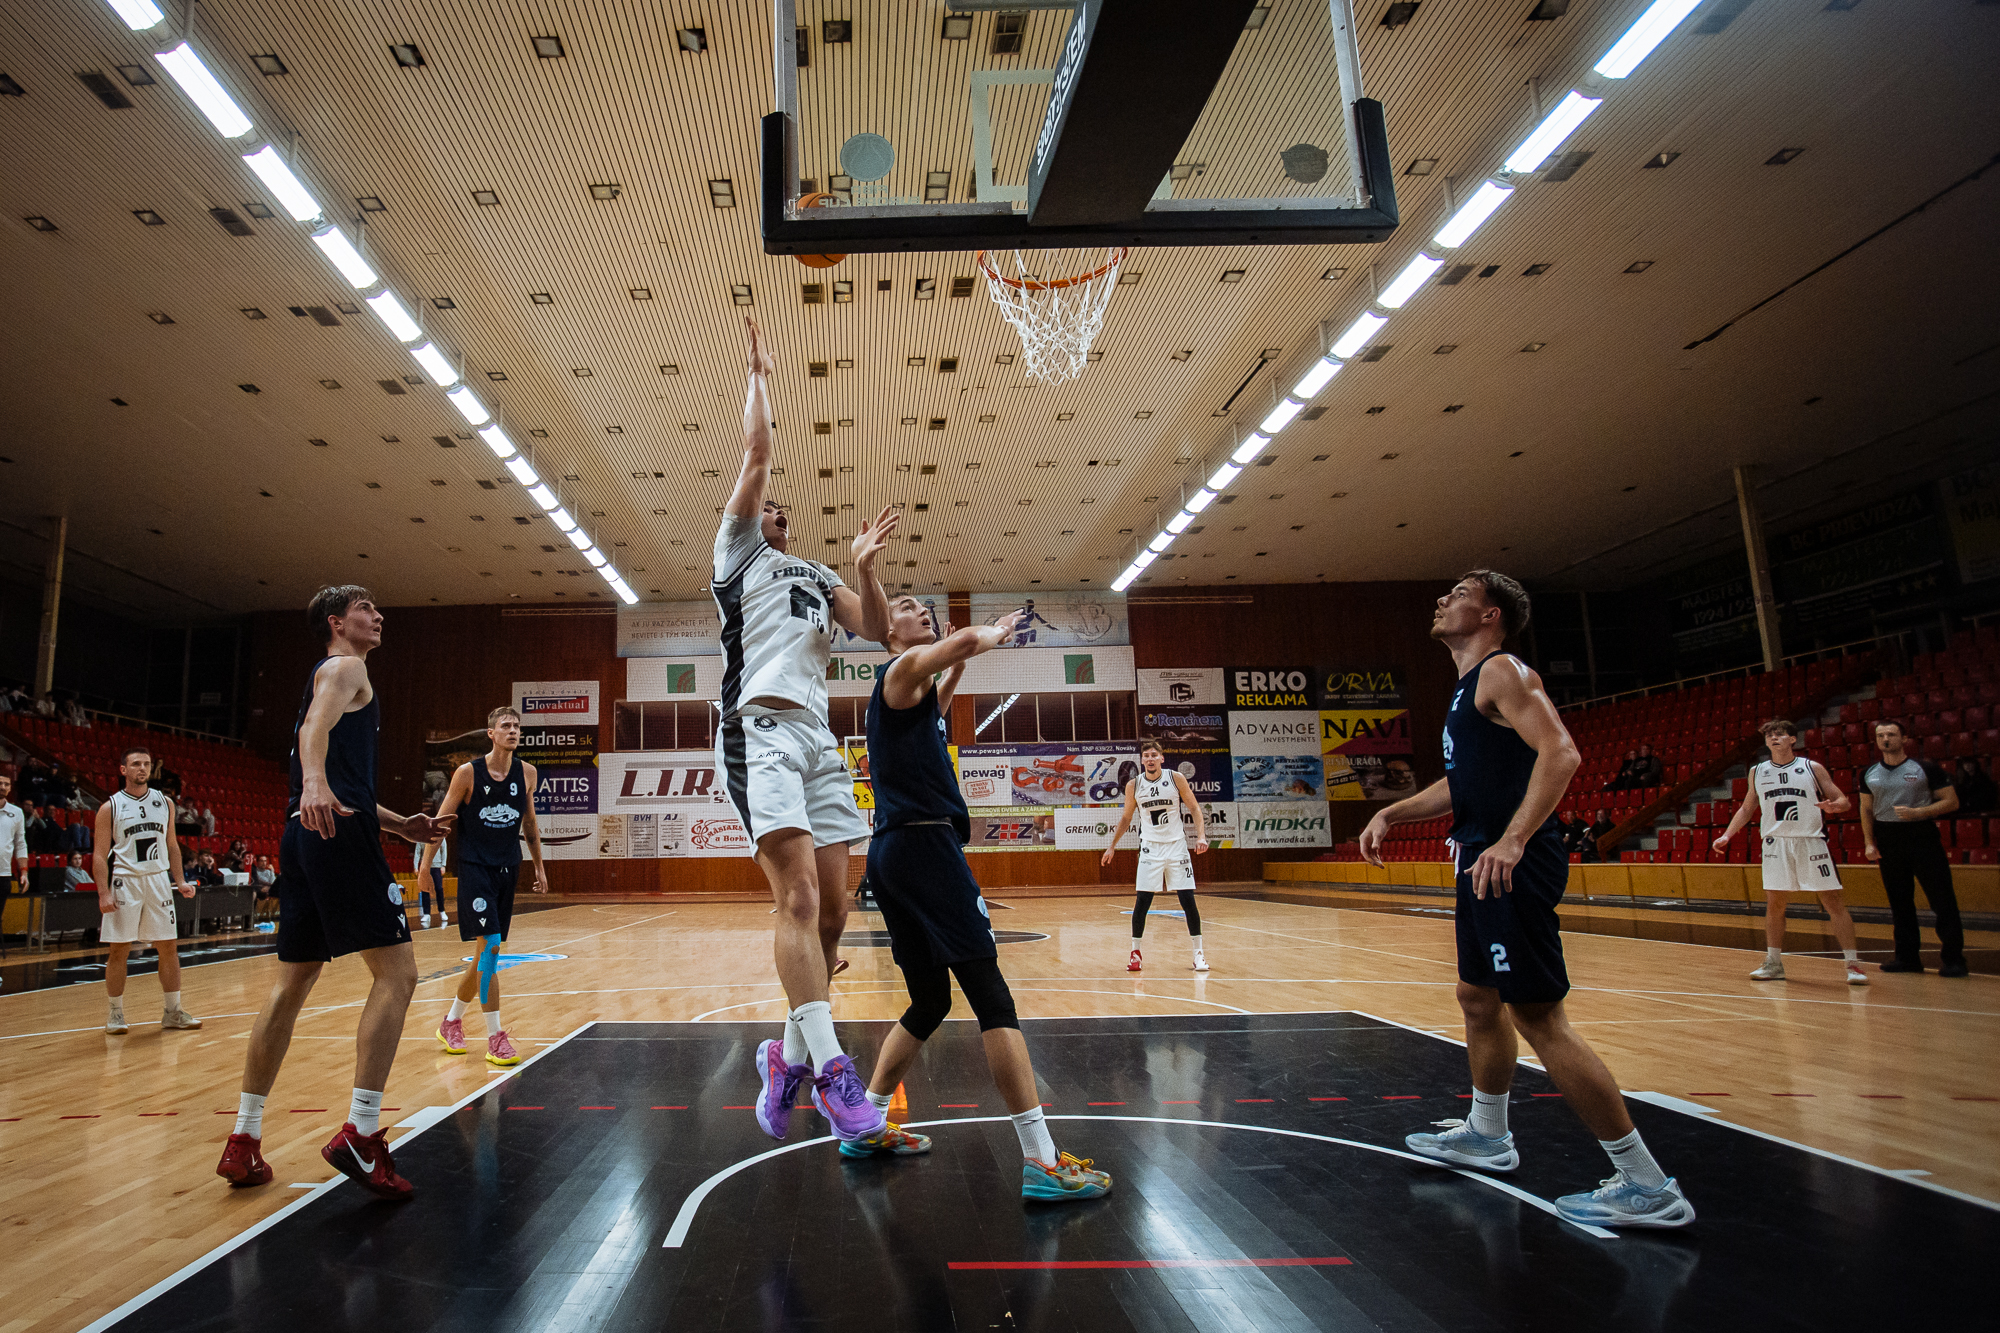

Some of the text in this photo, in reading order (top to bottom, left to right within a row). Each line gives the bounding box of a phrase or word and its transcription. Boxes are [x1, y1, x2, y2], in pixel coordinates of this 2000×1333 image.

[1235, 671, 1307, 691] ERKO
[1326, 672, 1395, 692] ORVA
[526, 697, 585, 710] Slovaktual
[1236, 694, 1308, 706] REKLAMA
[1452, 688, 1464, 711] 2
[1157, 713, 1223, 727] Ronchem
[1235, 723, 1315, 735] ADVANCE
[1322, 718, 1408, 738] NAVI
[963, 769, 1005, 780] pewag
[1778, 772, 1788, 784] 10
[510, 782, 518, 797] 9
[539, 778, 589, 793] ATTIS
[620, 769, 726, 797] L.I.R.
[1189, 780, 1222, 792] OLAUS
[1150, 787, 1159, 797] 24
[1764, 787, 1807, 800] PRIEVIDZA
[533, 796, 589, 804] ORTSWEAR
[1141, 799, 1174, 808] PRIEVIDZA
[139, 806, 146, 819] 3
[124, 822, 164, 838] PRIEVIDZA
[1257, 836, 1316, 844] www.nadka.sk
[1817, 864, 1830, 877] 10
[169, 910, 175, 925] 3
[1490, 943, 1510, 972] 2
